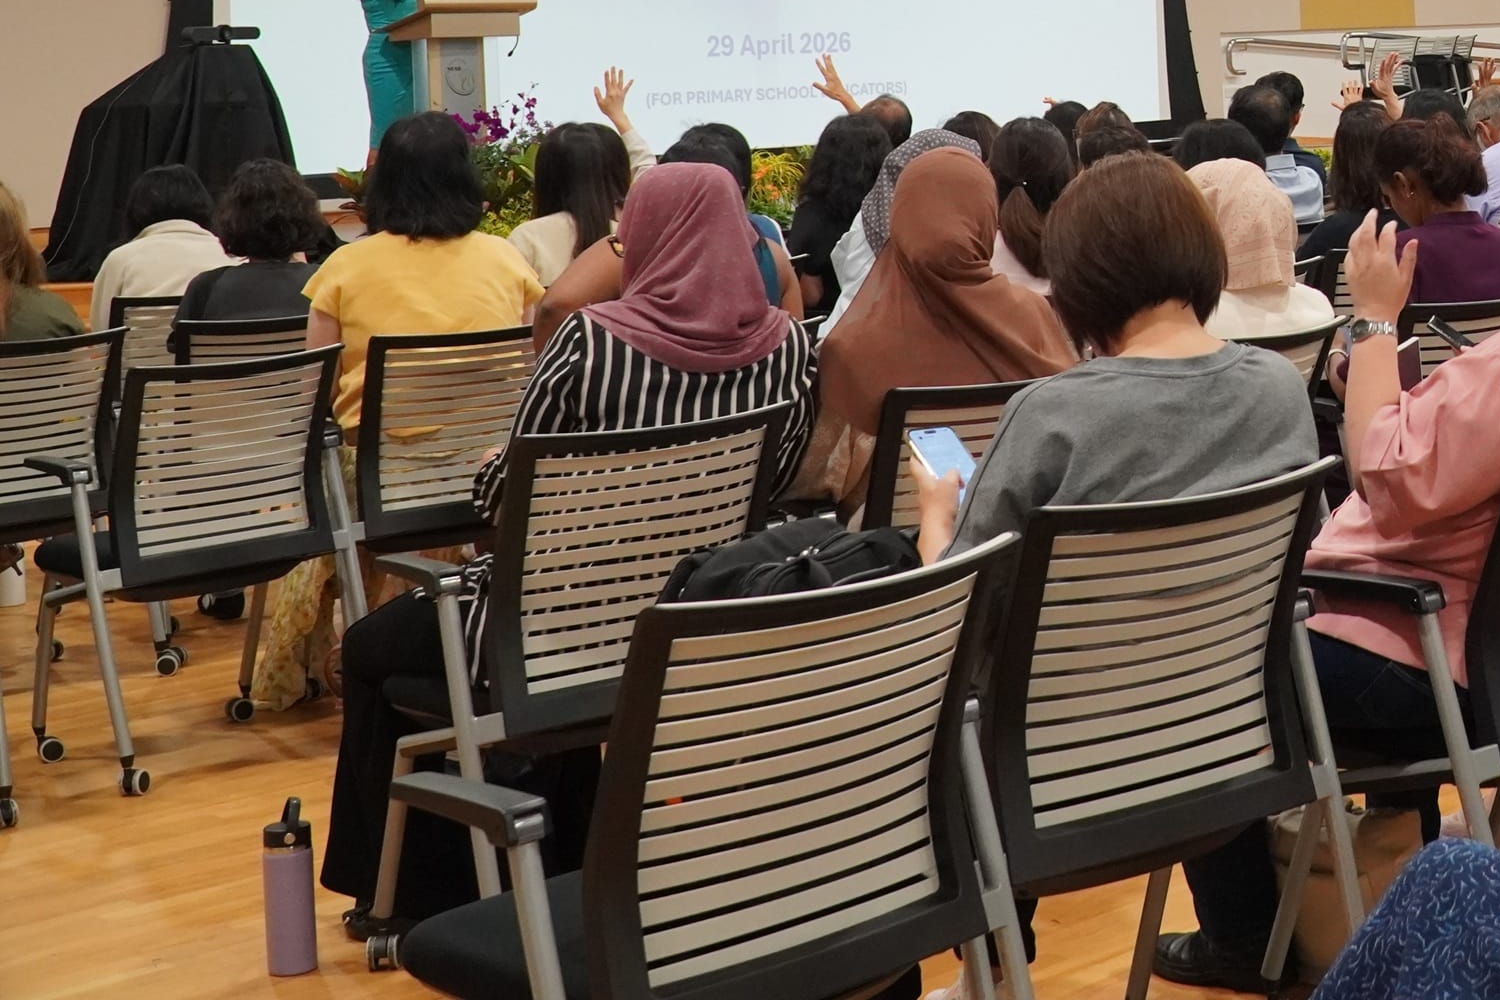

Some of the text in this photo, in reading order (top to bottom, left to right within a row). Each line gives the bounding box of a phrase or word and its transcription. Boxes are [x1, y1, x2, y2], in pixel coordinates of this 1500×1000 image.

[706, 31, 851, 60] 29 April 2026
[646, 92, 683, 110] (FOR
[686, 88, 753, 107] PRIMARY
[756, 84, 818, 101] SCHOOL
